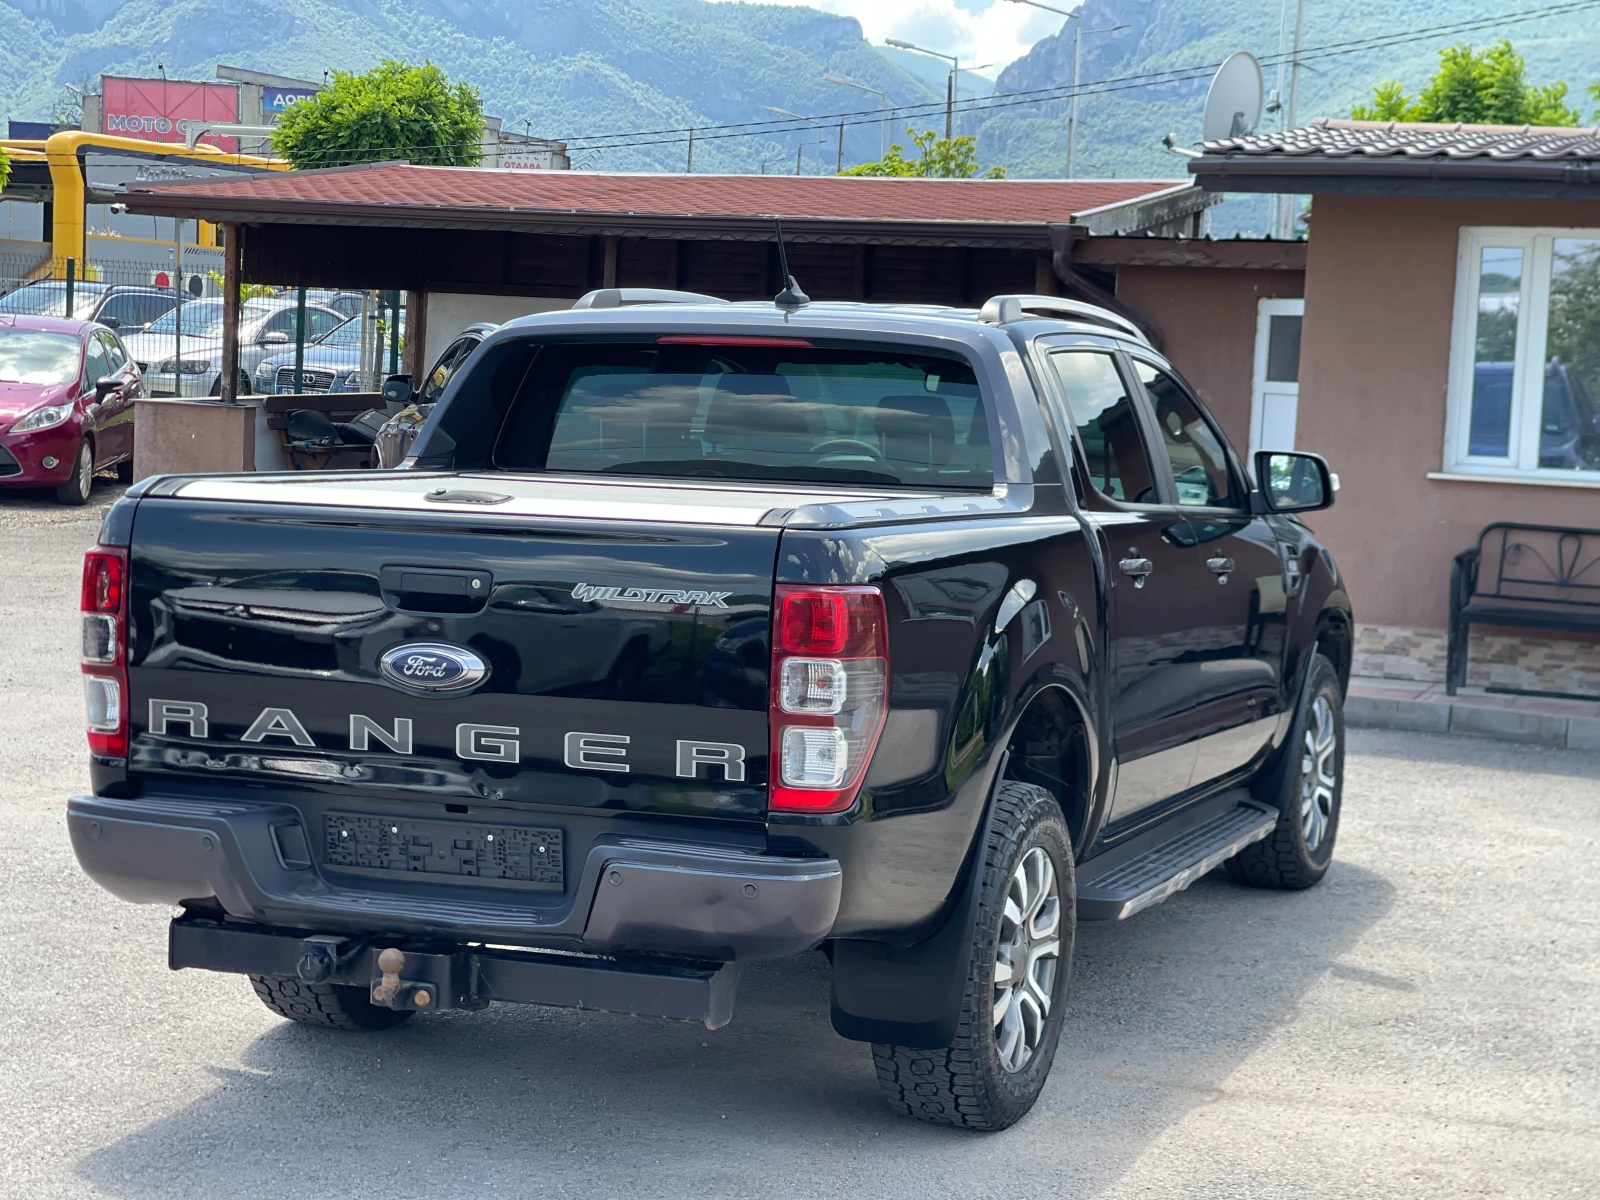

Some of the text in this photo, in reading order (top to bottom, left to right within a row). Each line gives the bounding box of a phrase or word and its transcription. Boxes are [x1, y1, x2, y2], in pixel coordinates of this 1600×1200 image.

[108, 114, 172, 134] МОТО
[571, 583, 733, 608] WILDTRAK
[403, 655, 447, 677] Ford
[148, 698, 746, 782] RANGER
